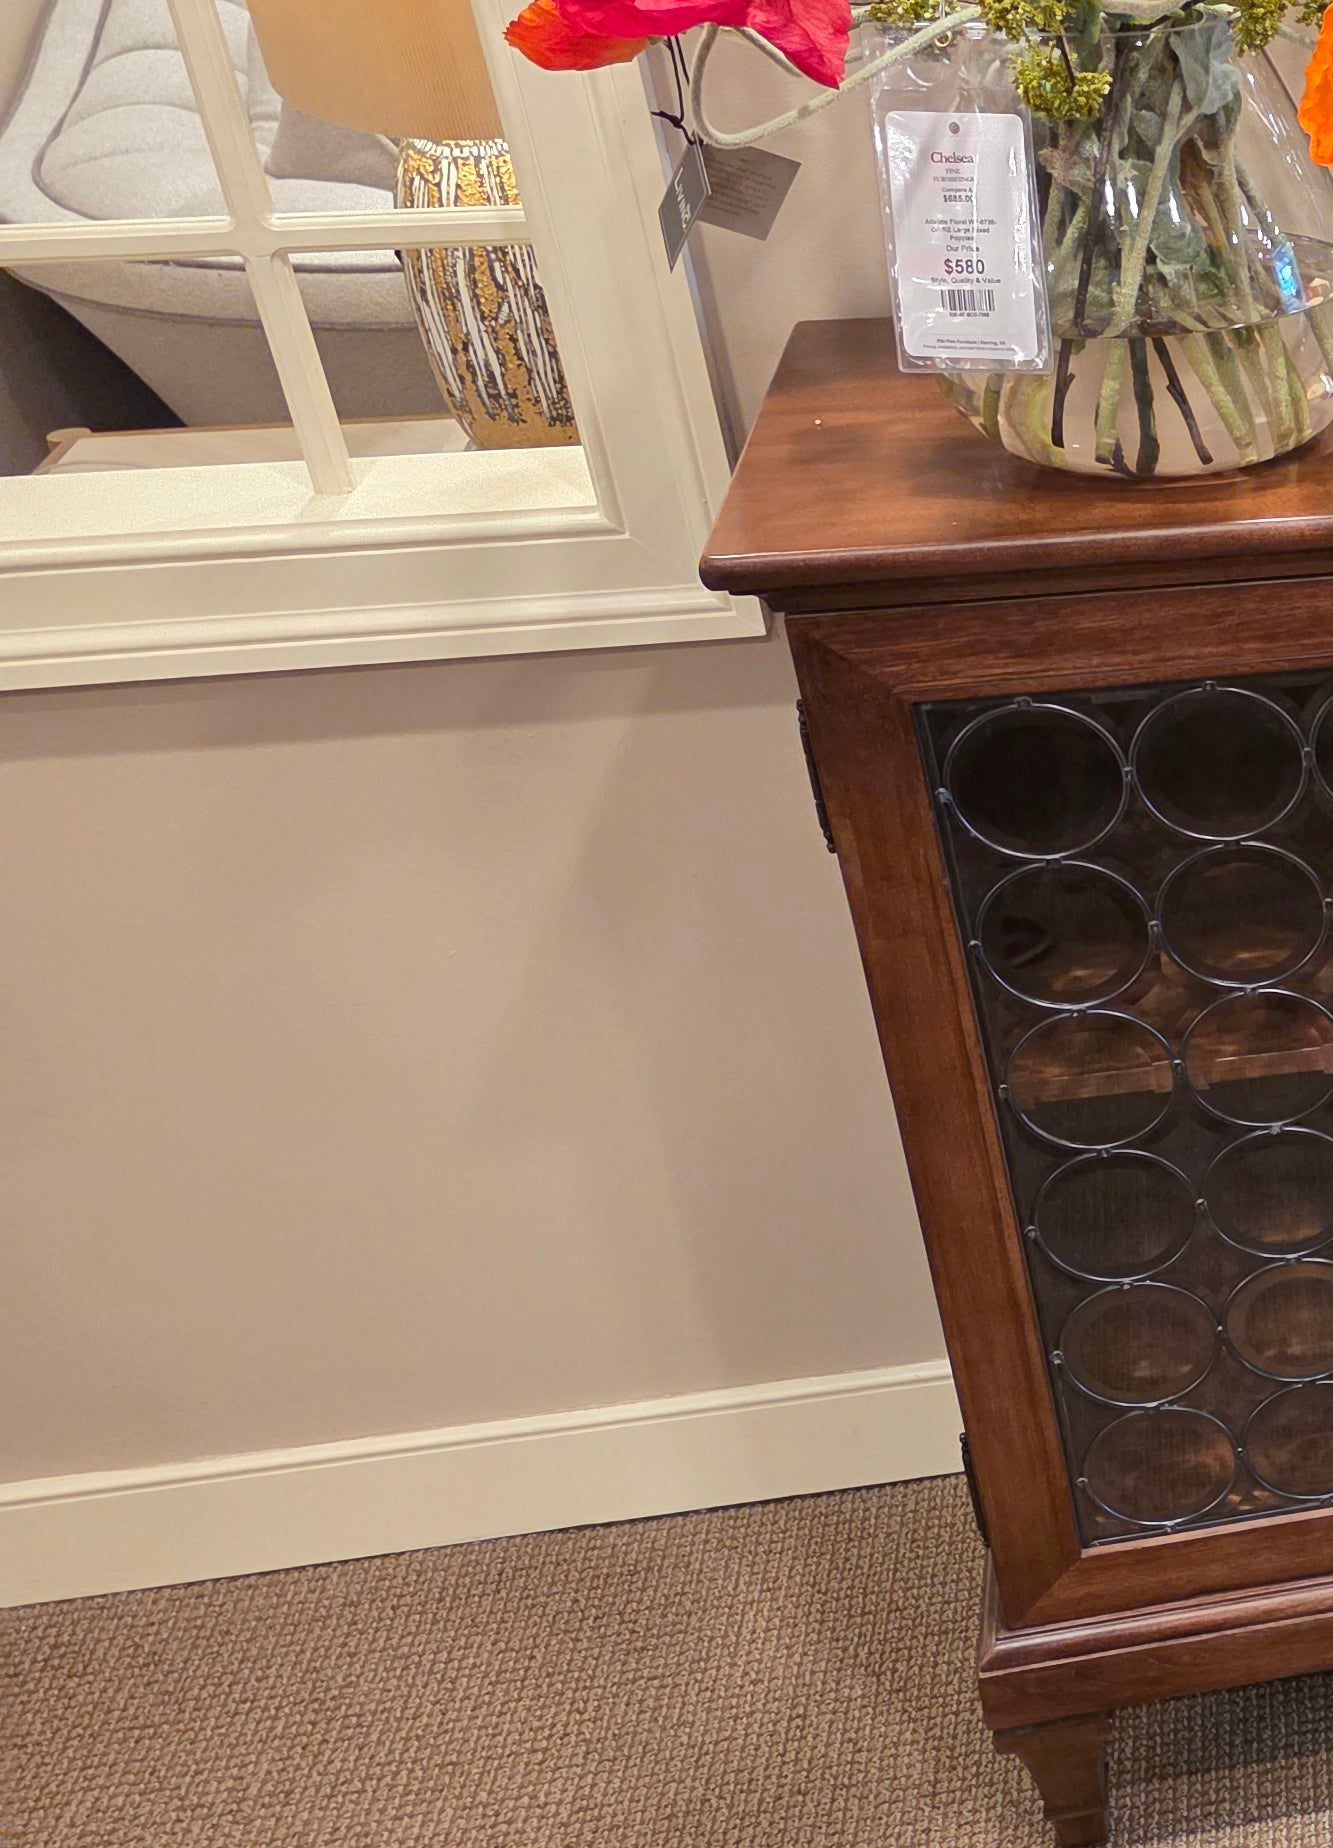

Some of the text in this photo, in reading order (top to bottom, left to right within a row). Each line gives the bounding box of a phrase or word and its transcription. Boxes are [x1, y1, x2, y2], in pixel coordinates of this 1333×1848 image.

[930, 151, 974, 164] Chelsea
[961, 244, 980, 252] Price
[944, 258, 985, 275] $580
[951, 277, 974, 285] Quality
